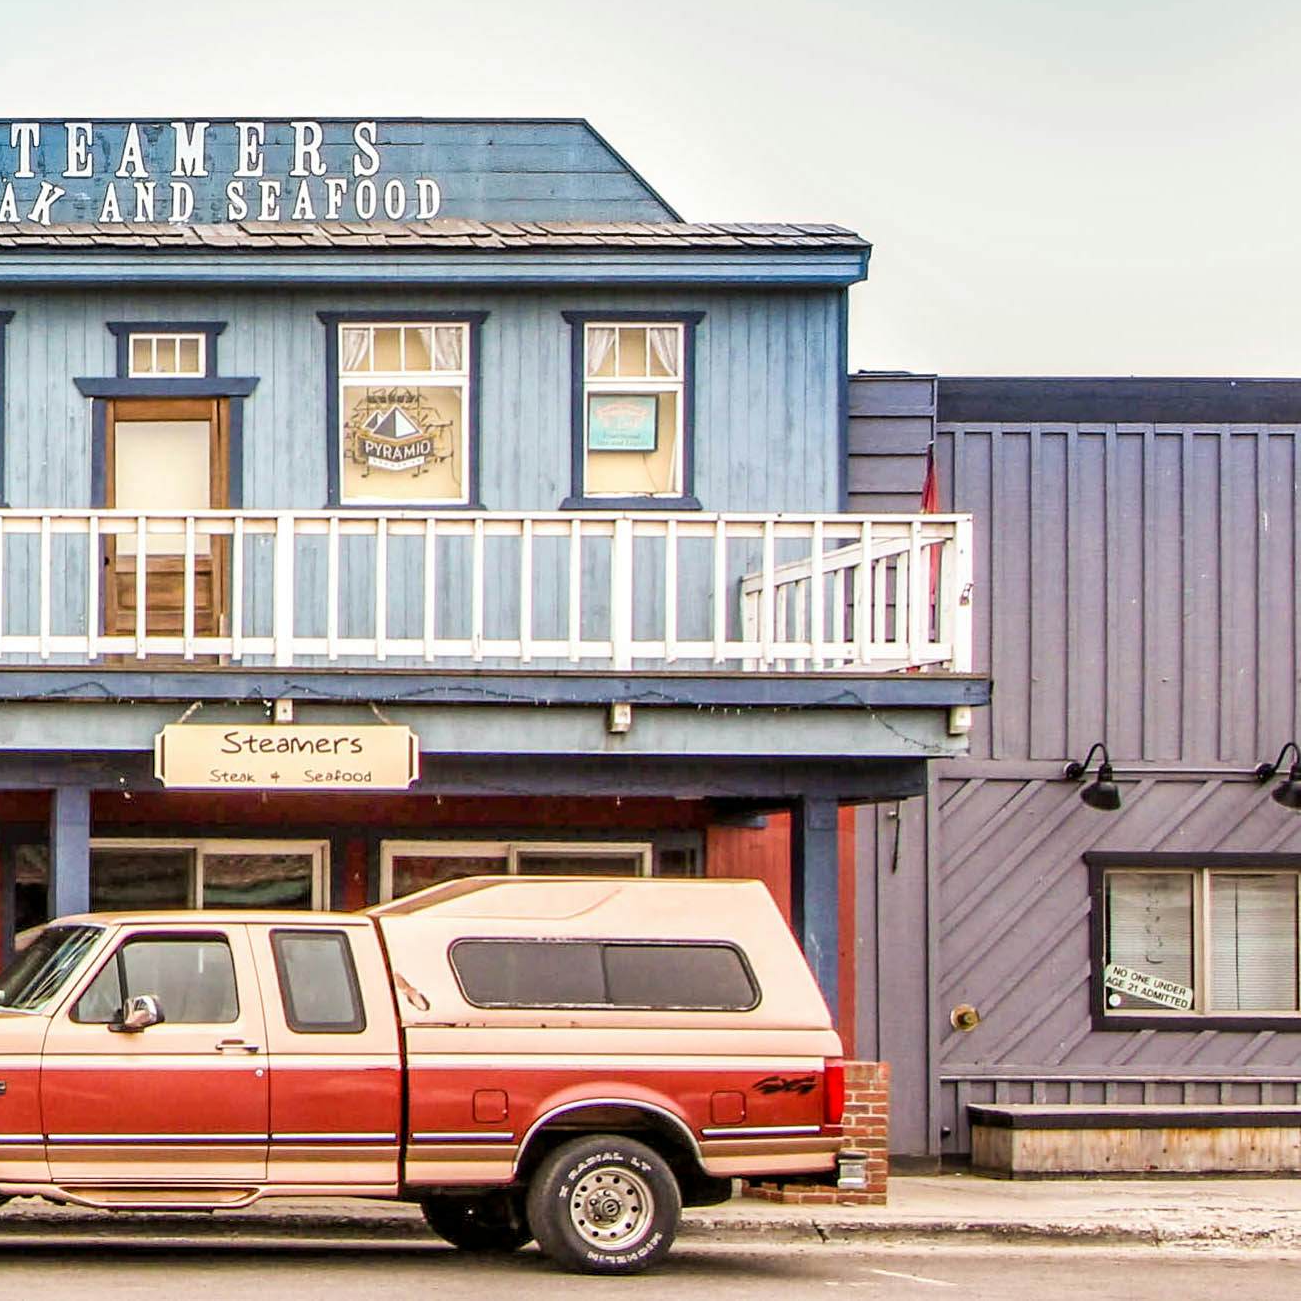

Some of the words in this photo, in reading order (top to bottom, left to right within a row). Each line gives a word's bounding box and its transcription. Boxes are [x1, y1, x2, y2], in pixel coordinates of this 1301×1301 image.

[98, 179, 195, 223] AND
[226, 177, 442, 222] SEAFOOD
[365, 440, 431, 459] PYRAMID
[221, 731, 364, 754] Steamers
[209, 769, 256, 783] Steak
[304, 769, 372, 783] Seafood
[1105, 976, 1126, 990] AGE
[1127, 982, 1139, 993] 21
[1140, 987, 1189, 1009] ADMITTED
[1112, 966, 1128, 978] NO
[1130, 972, 1151, 986] ONE
[1153, 978, 1186, 996] UNDER
[587, 1232, 662, 1264] MICHELIN
